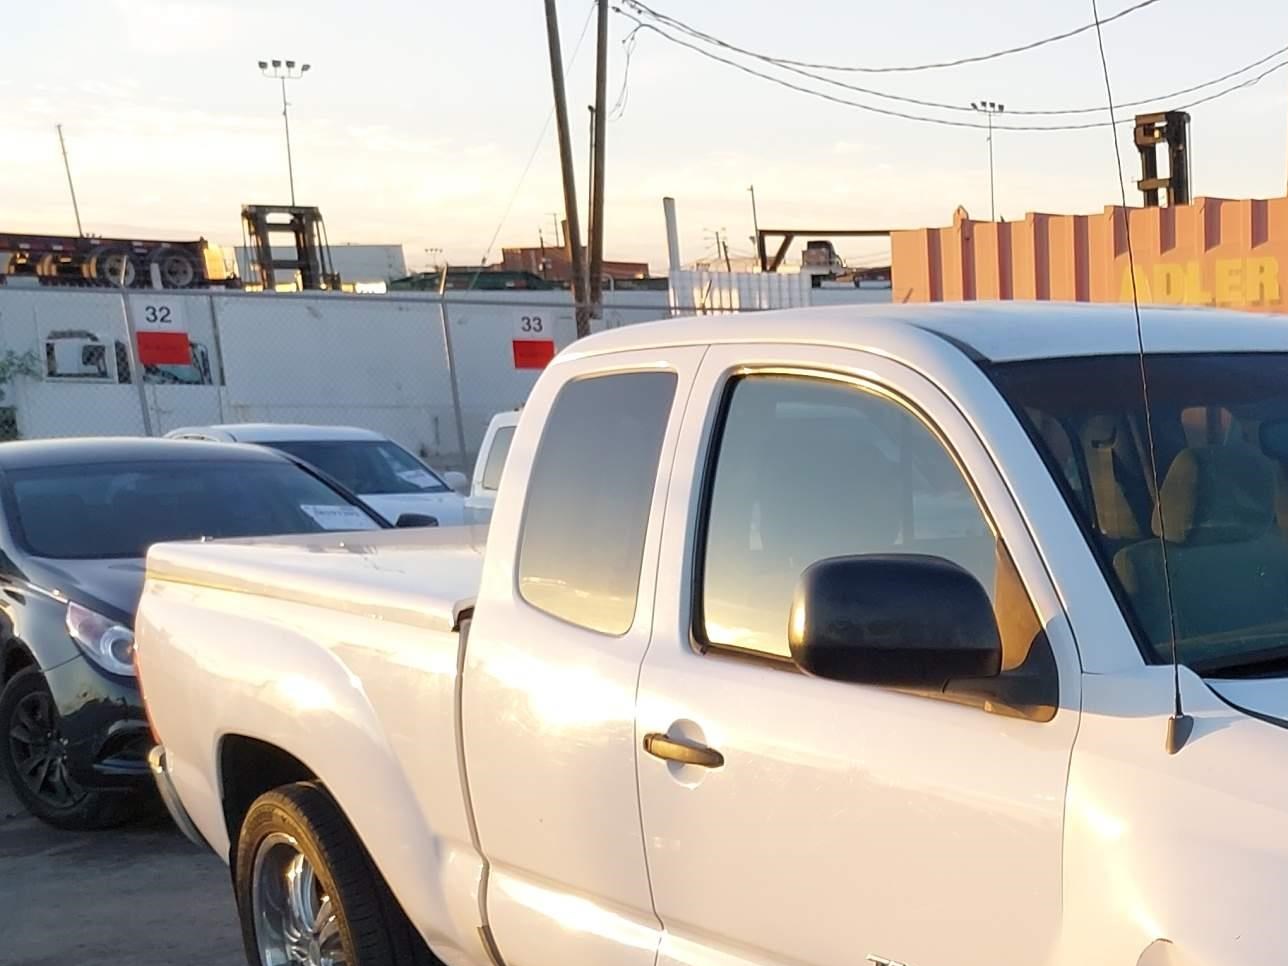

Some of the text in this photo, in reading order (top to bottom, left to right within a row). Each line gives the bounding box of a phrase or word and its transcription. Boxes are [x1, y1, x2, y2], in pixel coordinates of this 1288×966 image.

[1119, 255, 1281, 306] ADLER
[144, 305, 173, 324] 32
[520, 315, 544, 333] 33
